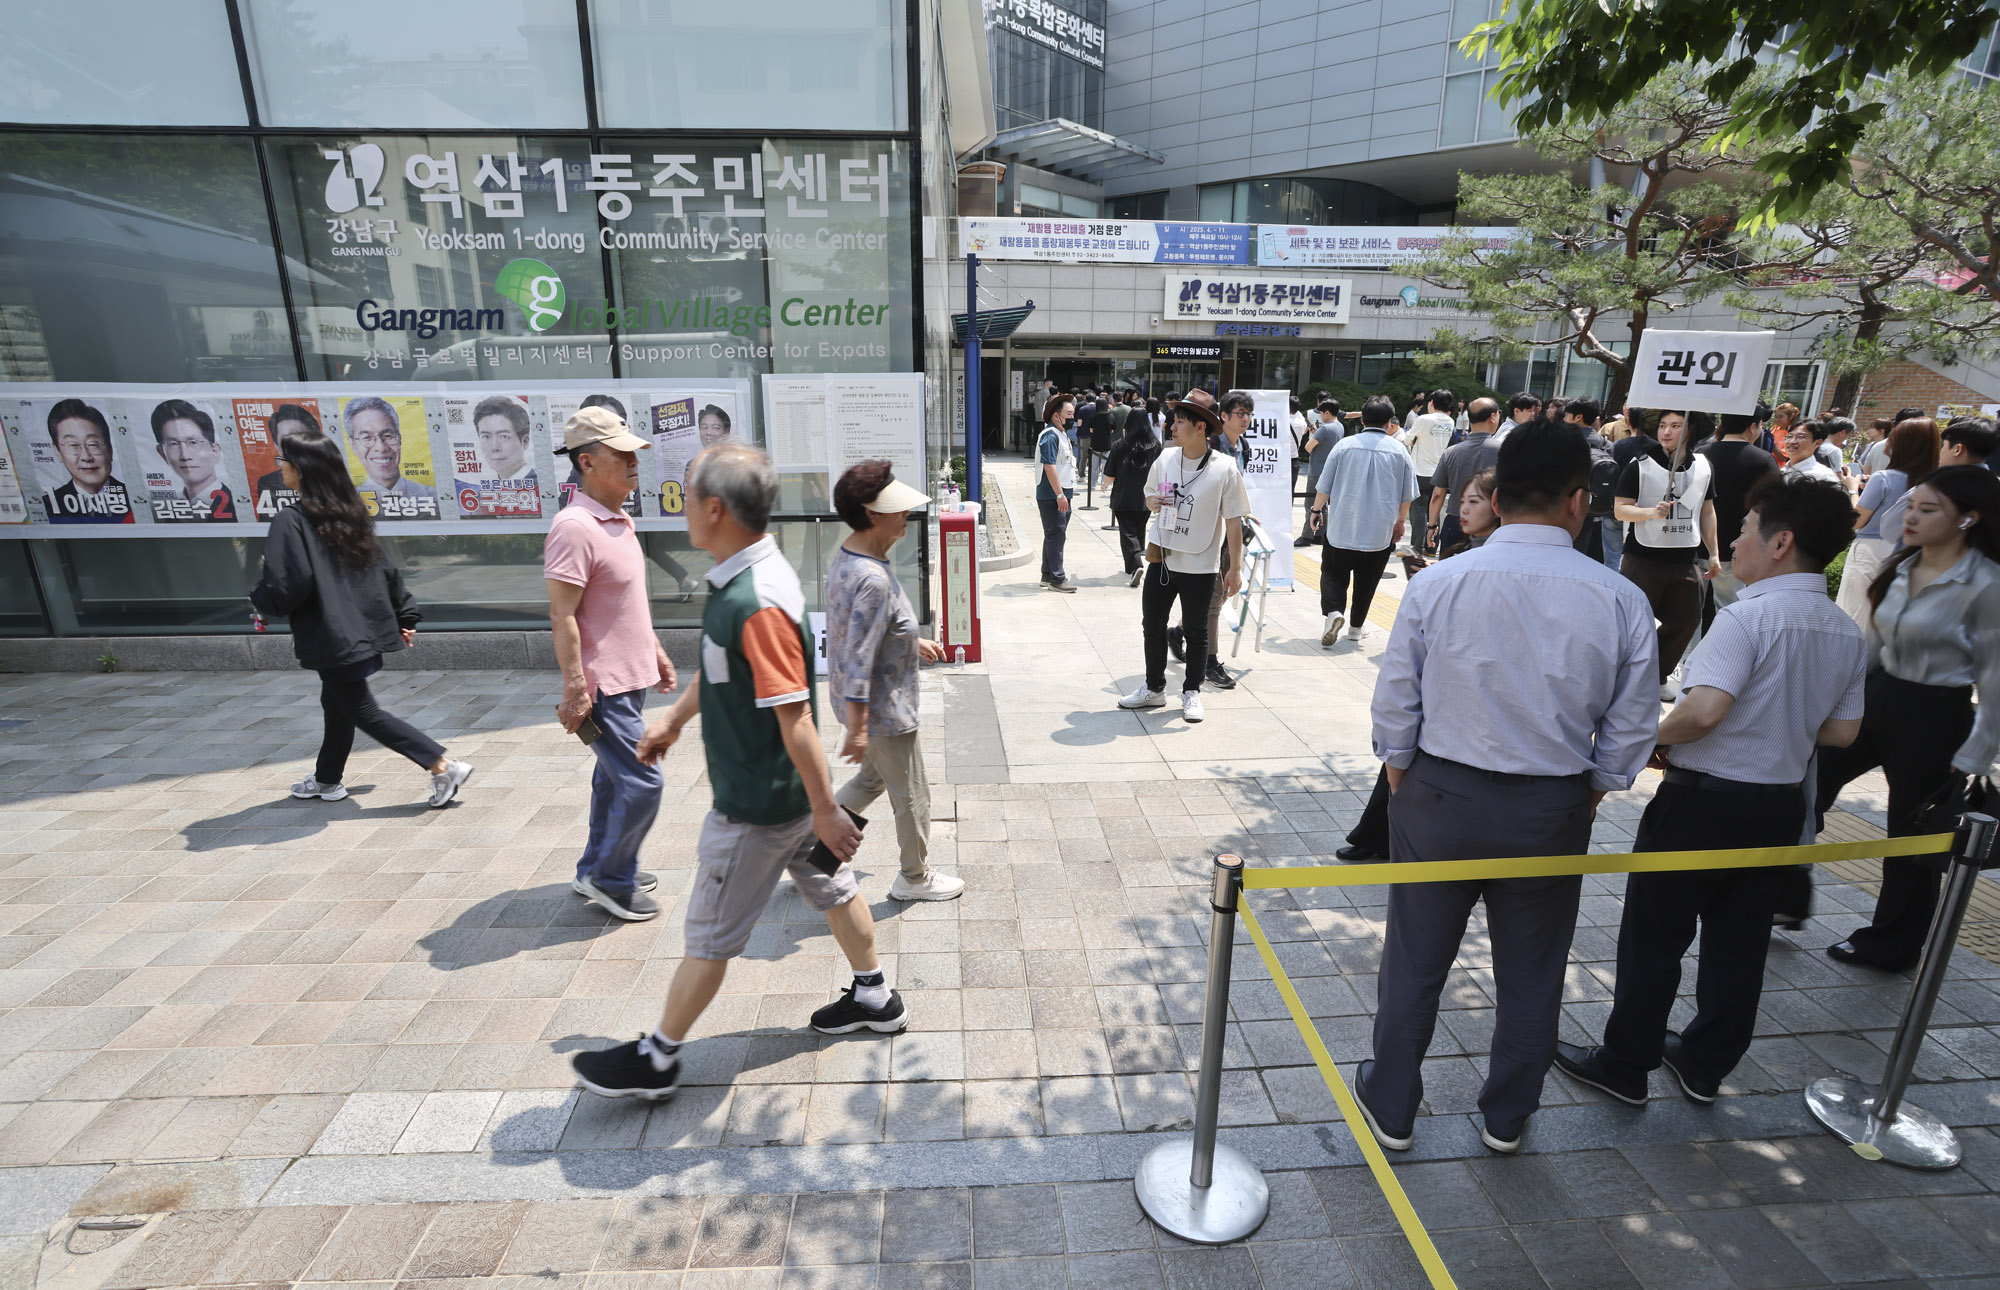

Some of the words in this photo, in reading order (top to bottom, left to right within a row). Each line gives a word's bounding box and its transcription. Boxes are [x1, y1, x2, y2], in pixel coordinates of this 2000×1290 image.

[1004, 15, 1026, 36] 1-dong
[1026, 26, 1059, 50] Community
[1059, 41, 1081, 60] Cultural
[1081, 50, 1104, 68] Complex
[404, 151, 889, 220] 역삼1동주민센터
[326, 218, 399, 244] 강남구
[1053, 223, 1086, 235] 분리배출
[1088, 224, 1104, 236] 거점
[414, 227, 506, 250] Yeoksam
[513, 227, 586, 254] 1-dong
[600, 227, 720, 254] Community
[728, 227, 806, 250] Service
[815, 227, 887, 250] Center
[999, 236, 1040, 248] 재활용품을
[1041, 238, 1090, 249] 종량제봉투로
[1092, 239, 1116, 250] 교환해
[1117, 240, 1150, 251] 드립니다
[1289, 238, 1312, 249] 세탁
[1312, 238, 1323, 249] 및
[1325, 238, 1335, 249] 짐
[1338, 238, 1360, 249] 보관
[1361, 239, 1392, 249] 서비스
[1206, 281, 1341, 306] 역삼1동주민센터
[1360, 295, 1400, 308] Gangnam
[1178, 303, 1202, 312] 강남구
[1206, 306, 1234, 315] Yeoksam
[1235, 307, 1257, 317] 1-dong
[1258, 308, 1292, 318] Community
[1293, 308, 1316, 318] Service
[1316, 309, 1338, 318] Center
[356, 299, 504, 340] Gangnam
[657, 296, 772, 336] Village
[780, 297, 889, 327] Center
[1228, 324, 1282, 336] 역삼로7길
[1287, 325, 1302, 337] 16
[363, 345, 593, 369] 강남글로벌빌리지센터
[622, 344, 702, 363] Support
[710, 343, 775, 359] Center
[784, 342, 810, 358] for
[818, 341, 887, 359] Expats
[1170, 347, 1220, 355] 무인민원발급창구
[1657, 350, 1738, 389] 관외
[236, 403, 274, 417] 미래를
[658, 401, 689, 418] 선경제,
[956, 388, 964, 429] 역삼도서관
[239, 417, 265, 431] 여는
[658, 413, 690, 431] 후정치!
[242, 432, 268, 445] 선택
[455, 450, 476, 462] 정치
[457, 462, 482, 473] 교체!
[103, 485, 124, 493] 지금은
[560, 483, 578, 505] 7
[661, 480, 683, 514] 8
[63, 493, 129, 514] 이재명
[153, 499, 212, 519] 김문수
[209, 489, 233, 519] 2
[256, 489, 278, 518] 4
[359, 491, 380, 517] 5
[381, 496, 437, 517] 권영국
[459, 488, 480, 513] 6
[480, 490, 540, 513] 구주와
[1174, 525, 1190, 536] 안내
[1661, 525, 1693, 533] 투표안내
